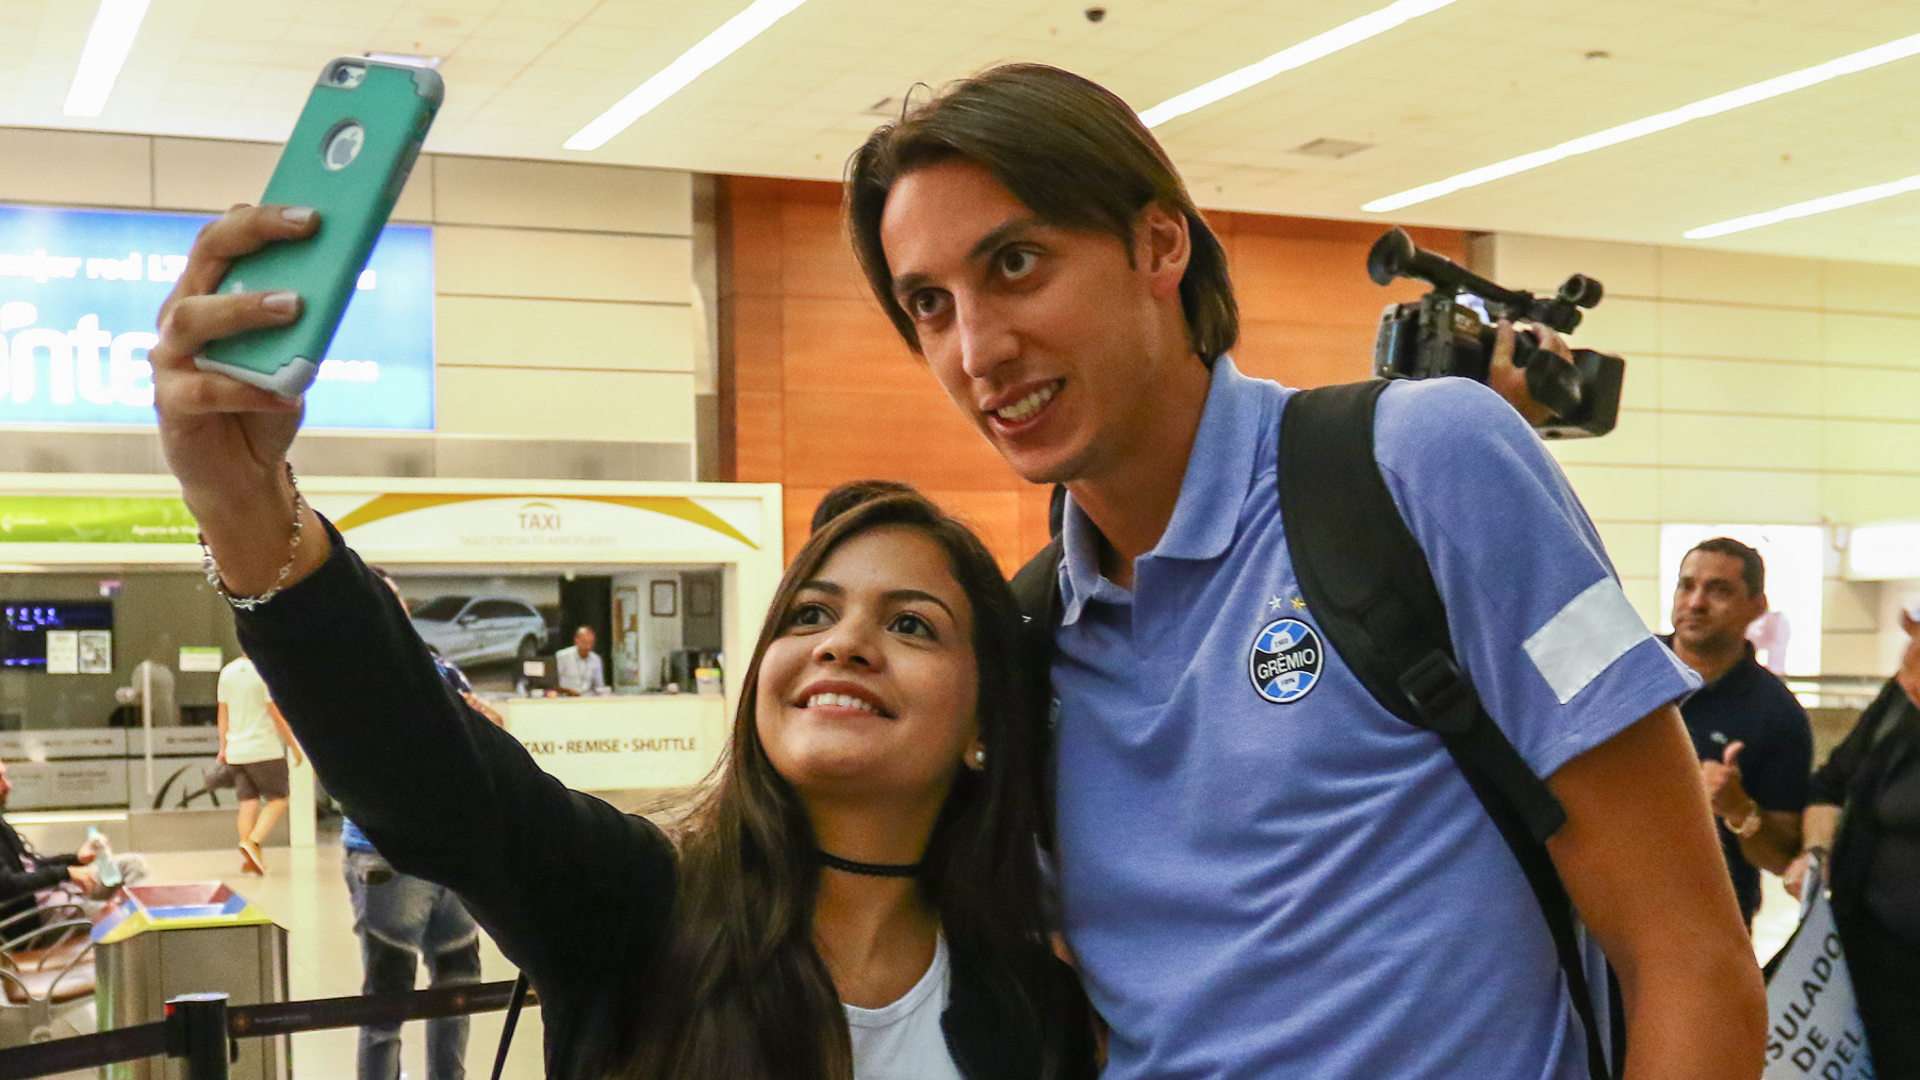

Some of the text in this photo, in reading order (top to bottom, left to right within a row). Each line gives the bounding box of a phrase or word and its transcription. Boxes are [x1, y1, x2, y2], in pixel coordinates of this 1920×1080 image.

[147, 254, 187, 282] LT
[518, 512, 561, 530] TAXI
[1257, 648, 1316, 680] GRÊMIO
[566, 739, 620, 754] REMISE
[631, 736, 696, 752] SHUTTLE
[1765, 932, 1843, 1062] SULADO
[1791, 1026, 1830, 1073] DE
